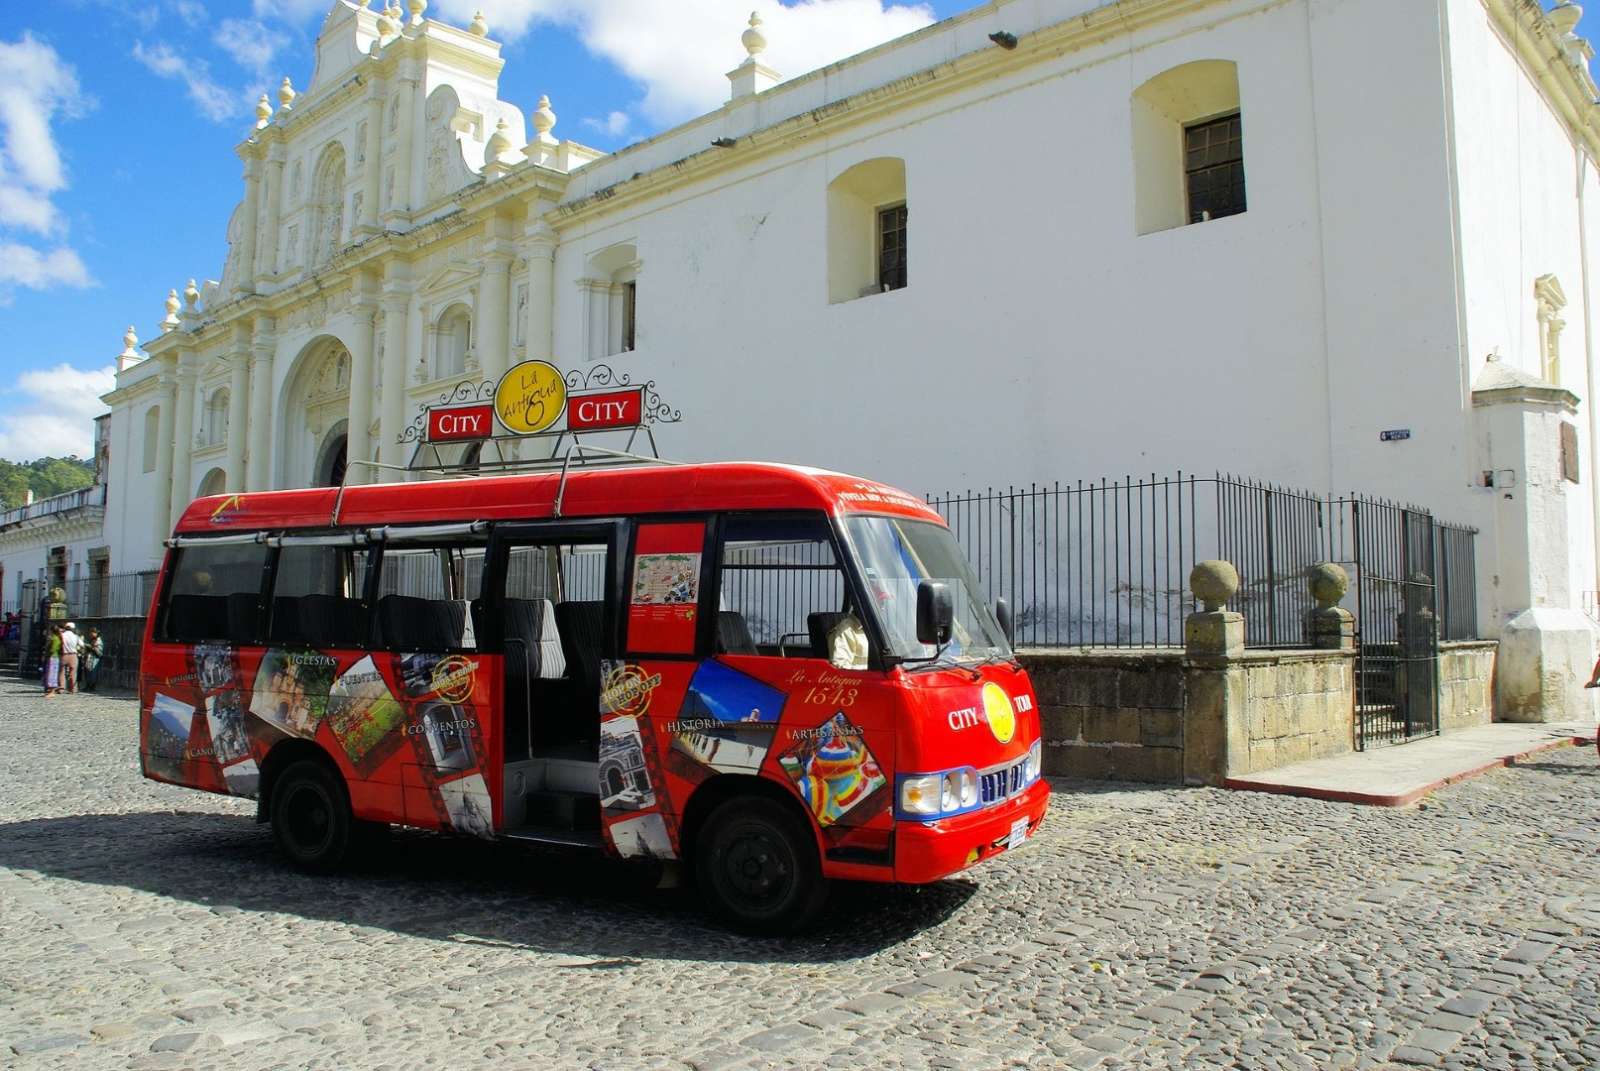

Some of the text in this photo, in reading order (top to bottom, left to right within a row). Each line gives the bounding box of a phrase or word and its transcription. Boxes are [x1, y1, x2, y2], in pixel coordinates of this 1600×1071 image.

[521, 370, 538, 390] La
[577, 400, 629, 423] CITY
[438, 414, 482, 434] CITY
[291, 654, 338, 666] IGLESIAS
[407, 717, 476, 735] CONVENTOS
[666, 718, 726, 733] HISTORIA
[948, 707, 979, 730] CITY
